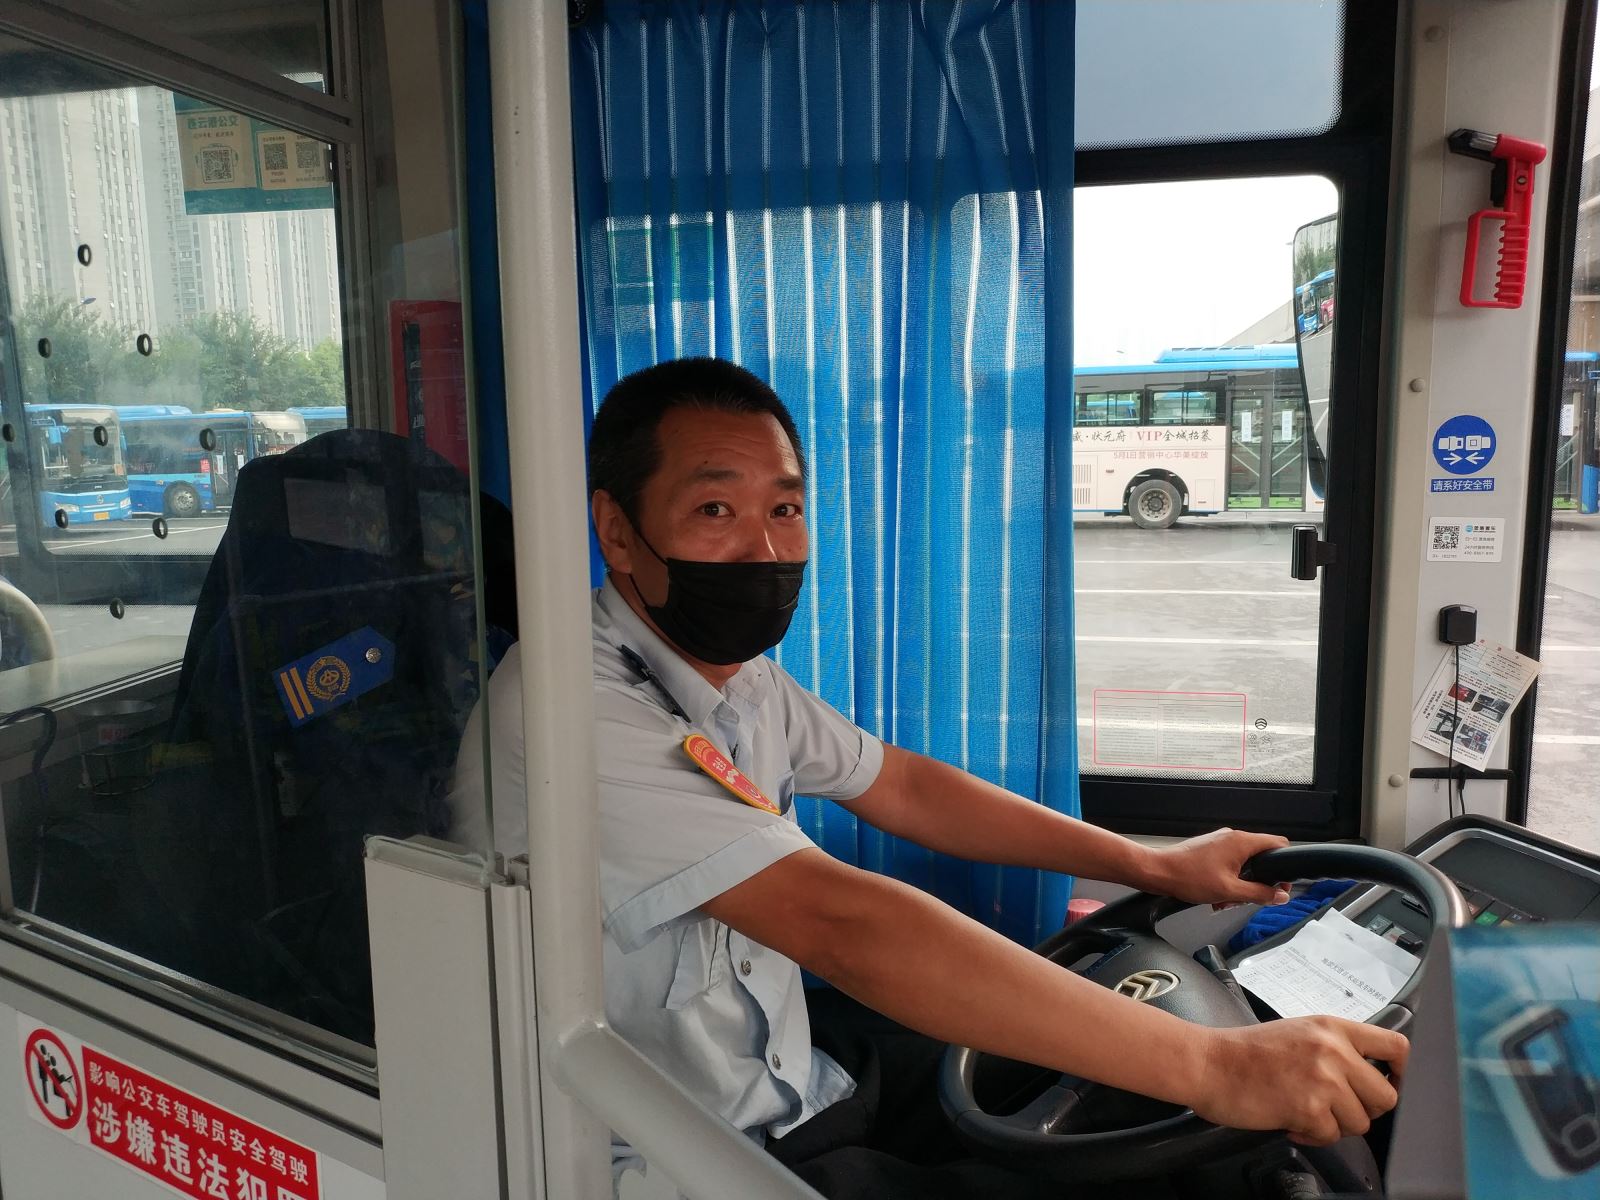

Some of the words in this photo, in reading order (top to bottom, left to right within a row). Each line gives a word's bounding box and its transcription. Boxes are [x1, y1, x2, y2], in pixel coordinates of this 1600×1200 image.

[1433, 479, 1493, 491] 请系好安全带
[89, 1061, 309, 1186] 影响公交车驾驶员安全驾驶
